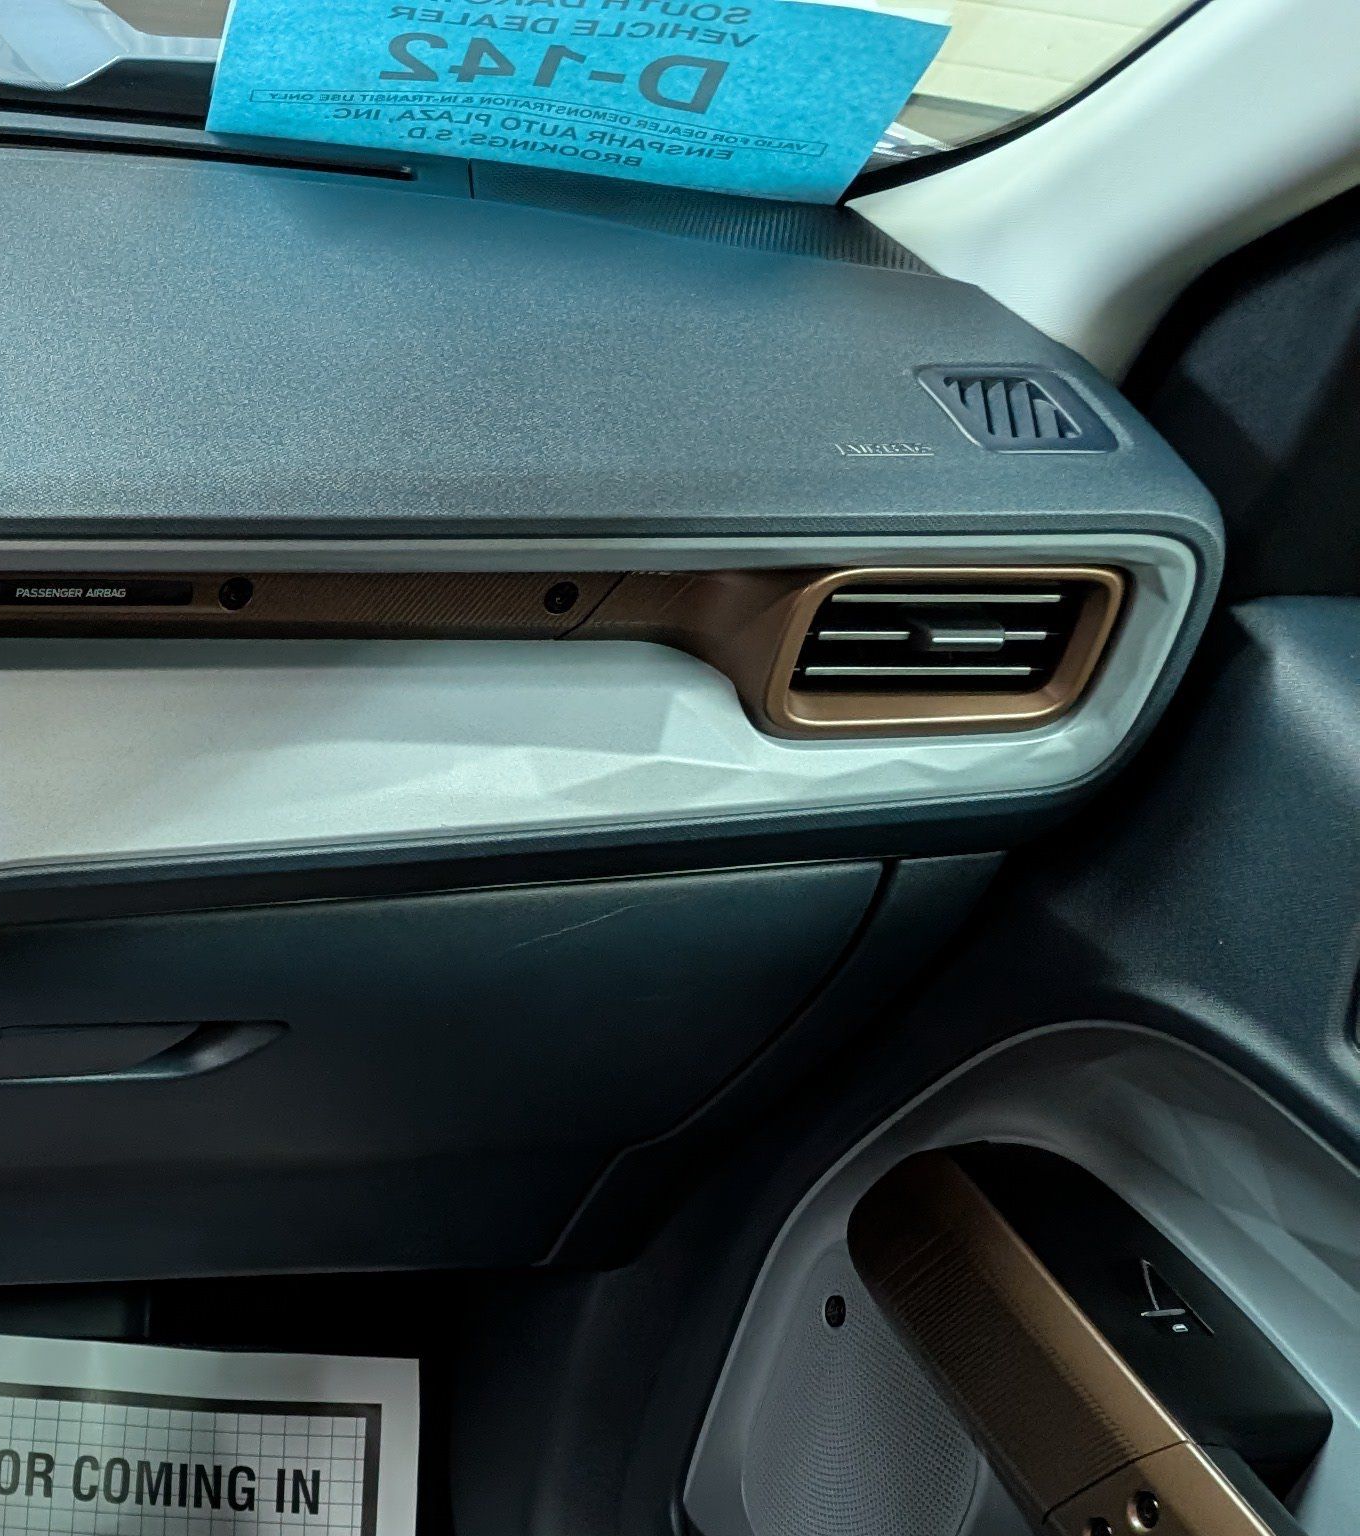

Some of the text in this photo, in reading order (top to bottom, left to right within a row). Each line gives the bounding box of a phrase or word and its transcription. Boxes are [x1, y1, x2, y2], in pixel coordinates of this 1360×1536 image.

[15, 587, 126, 598] PASSENGER AIRBAG
[71, 1455, 256, 1512] COMING
[275, 1468, 321, 1515] IN
